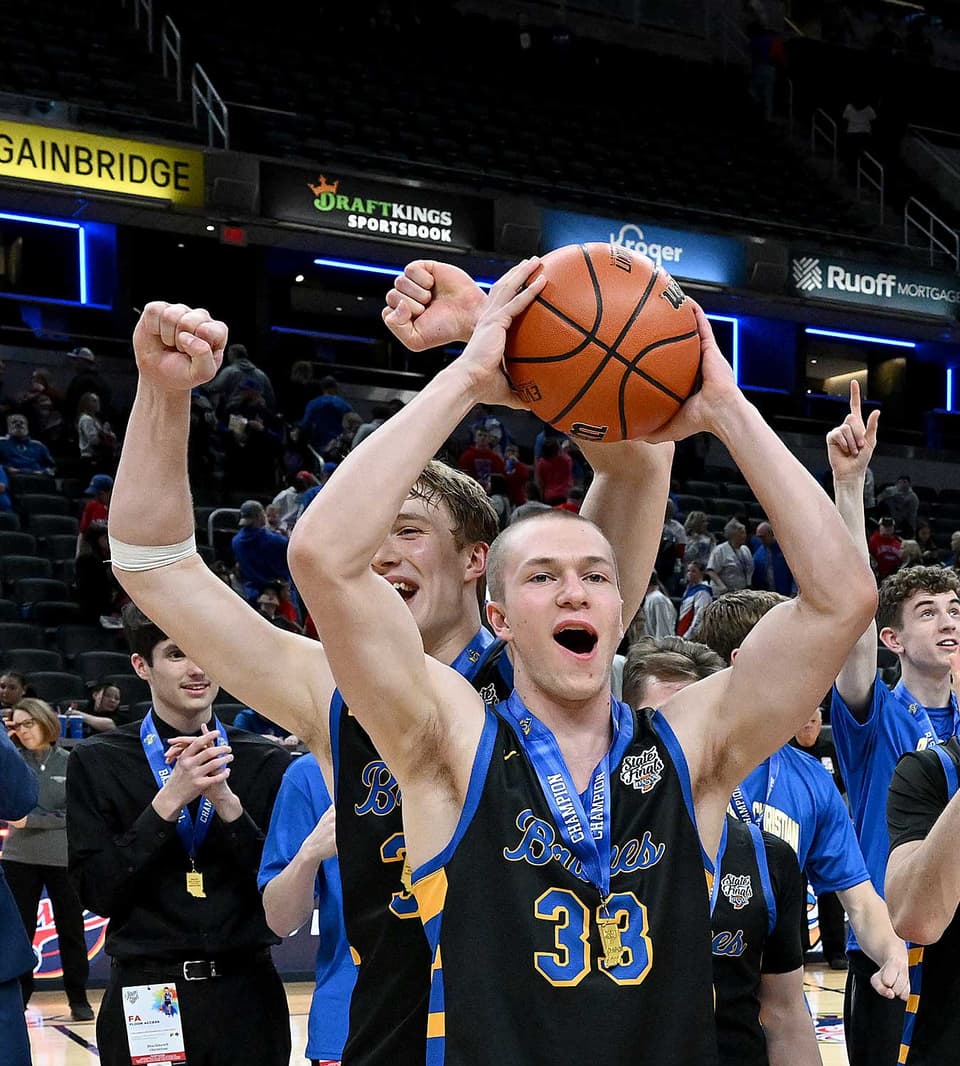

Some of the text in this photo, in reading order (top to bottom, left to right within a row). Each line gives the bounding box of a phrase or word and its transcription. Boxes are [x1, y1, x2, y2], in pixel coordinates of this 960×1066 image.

[0, 133, 191, 192] GAINBRIDGE
[348, 214, 452, 242] SPORTSBOOK
[826, 264, 897, 298] Ruoff
[620, 758, 665, 786] Finals
[622, 744, 657, 771] State
[546, 773, 585, 844] CHAMPION
[589, 771, 606, 841] CHAMPION
[533, 886, 654, 987] 33
